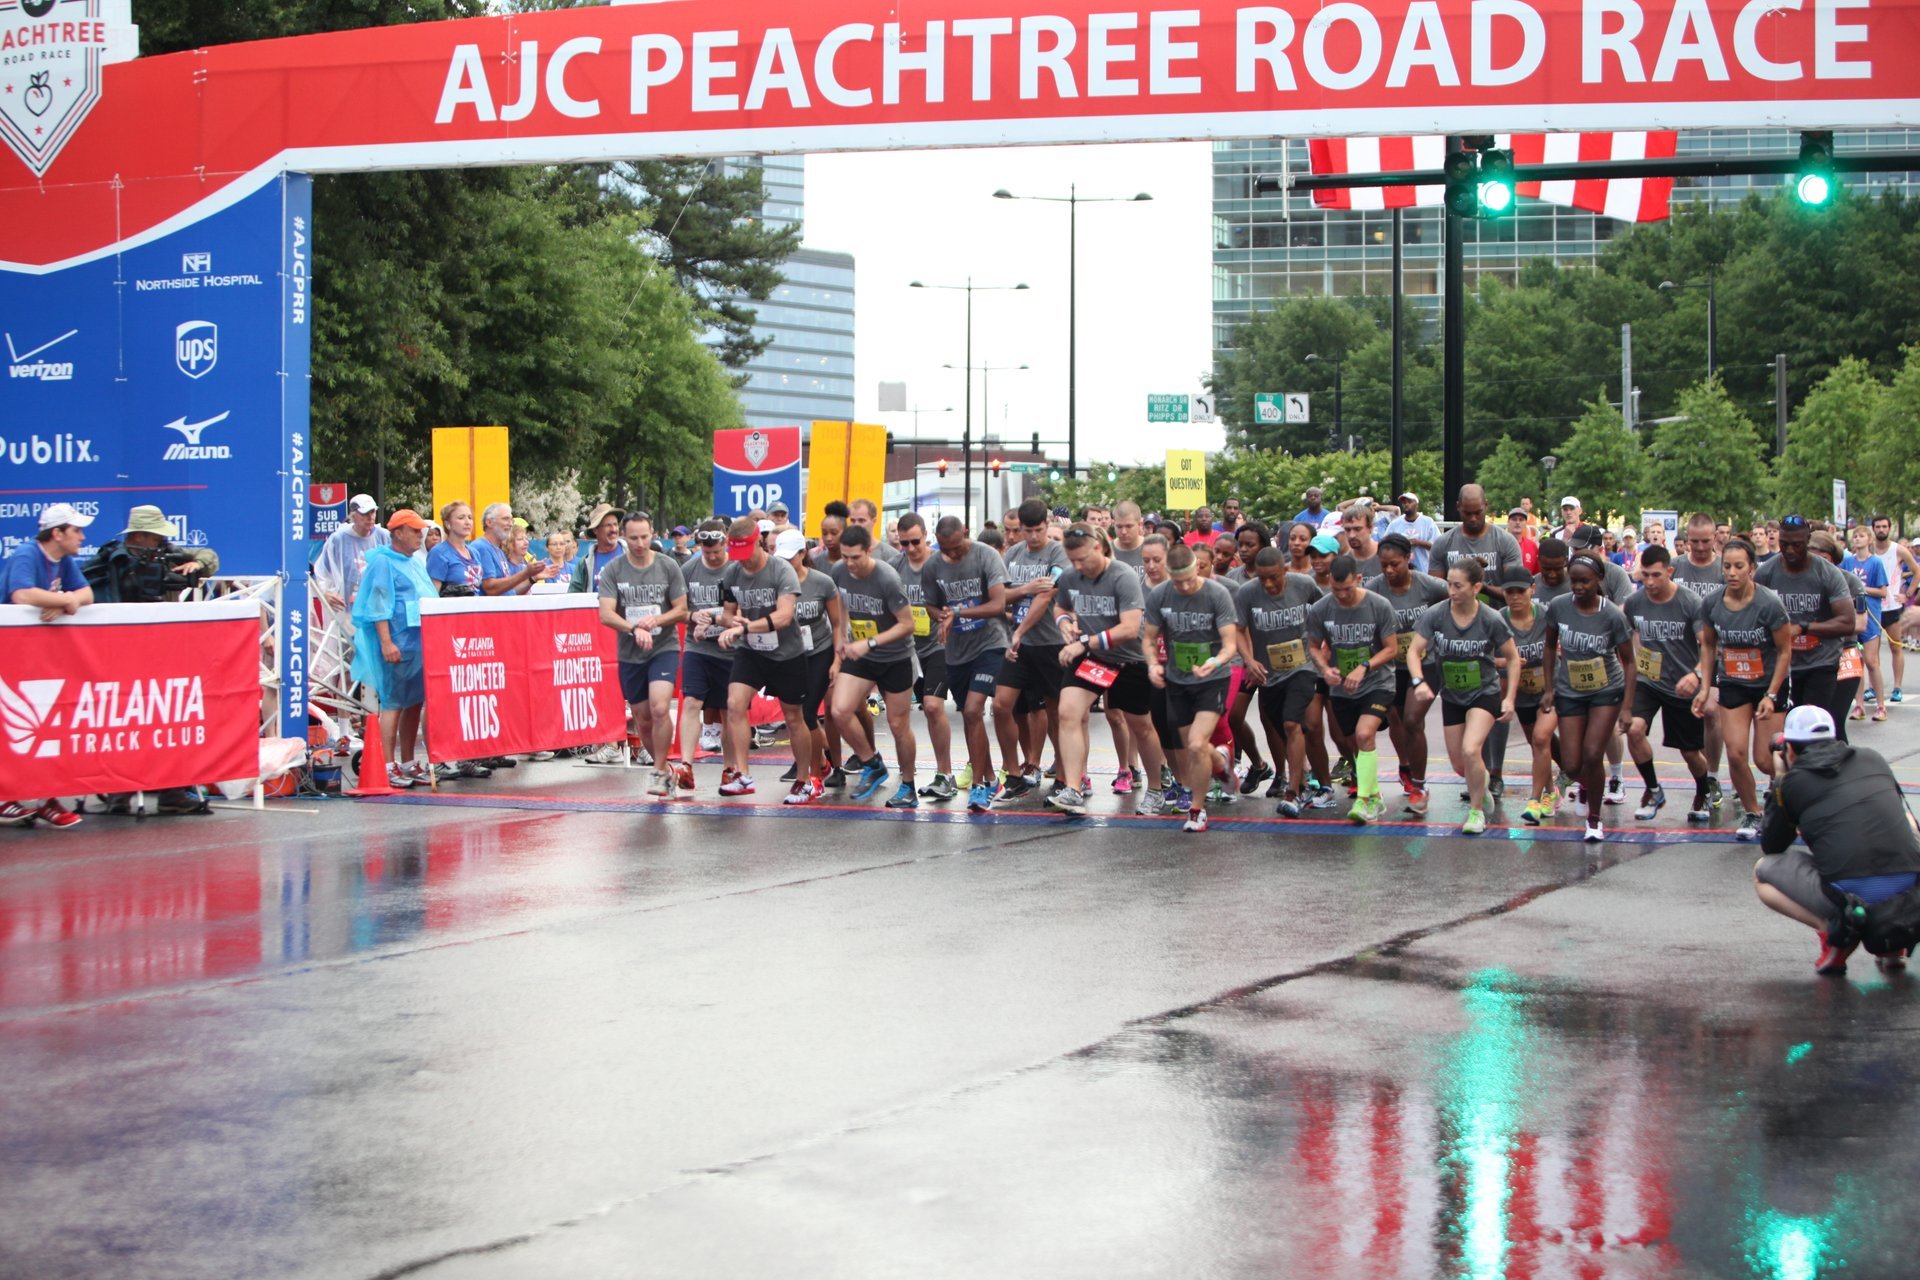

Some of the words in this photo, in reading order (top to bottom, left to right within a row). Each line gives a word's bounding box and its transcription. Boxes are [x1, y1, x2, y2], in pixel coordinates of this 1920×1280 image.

[0, 22, 105, 50] ACHTREE
[4, 53, 34, 65] ROAD
[41, 50, 71, 59] RACE
[434, 36, 602, 124] AJC
[629, 10, 1201, 116] PEACHTREE
[1234, 0, 1547, 94] ROAD
[1581, 0, 1873, 84] RACE
[292, 217, 305, 325] #AJCPRR
[136, 278, 200, 291] NORTHSIDE
[203, 275, 263, 287] HOSPITAL
[180, 338, 214, 370] ups
[9, 359, 74, 380] verizon
[1153, 404, 1170, 412] RITZ
[1172, 404, 1183, 412] DR
[1261, 407, 1278, 418] 400
[1149, 412, 1175, 421] PHIPPS
[1177, 412, 1188, 421] DR
[1180, 458, 1192, 471] GOT
[292, 432, 304, 541] #AJCPRR
[1169, 477, 1204, 490] QUESTIONS?
[731, 483, 783, 512] TOP
[0, 503, 31, 518] EDIA
[33, 501, 100, 517] PAERS
[317, 510, 338, 522] SUB
[314, 521, 341, 533] SEED
[467, 637, 495, 650] ATLANTA
[568, 632, 592, 646] ATLANTA
[757, 635, 763, 643] 2
[290, 609, 303, 719] #AJCPRR
[1186, 655, 1199, 665] 17
[1280, 654, 1294, 663] 33
[1640, 660, 1650, 671] 35
[553, 656, 603, 686] KILOMETER
[1089, 667, 1105, 678] 42
[1736, 661, 1750, 672] 30
[450, 662, 506, 693] KILOMETER
[974, 673, 995, 684] NAVY
[1454, 674, 1467, 684] 21
[1580, 672, 1594, 682] 38
[70, 675, 206, 730] ATLANTA
[560, 686, 598, 732] KIDS
[459, 694, 501, 742] KIDS
[70, 729, 145, 754] TRACK
[153, 724, 206, 748] CLUB
